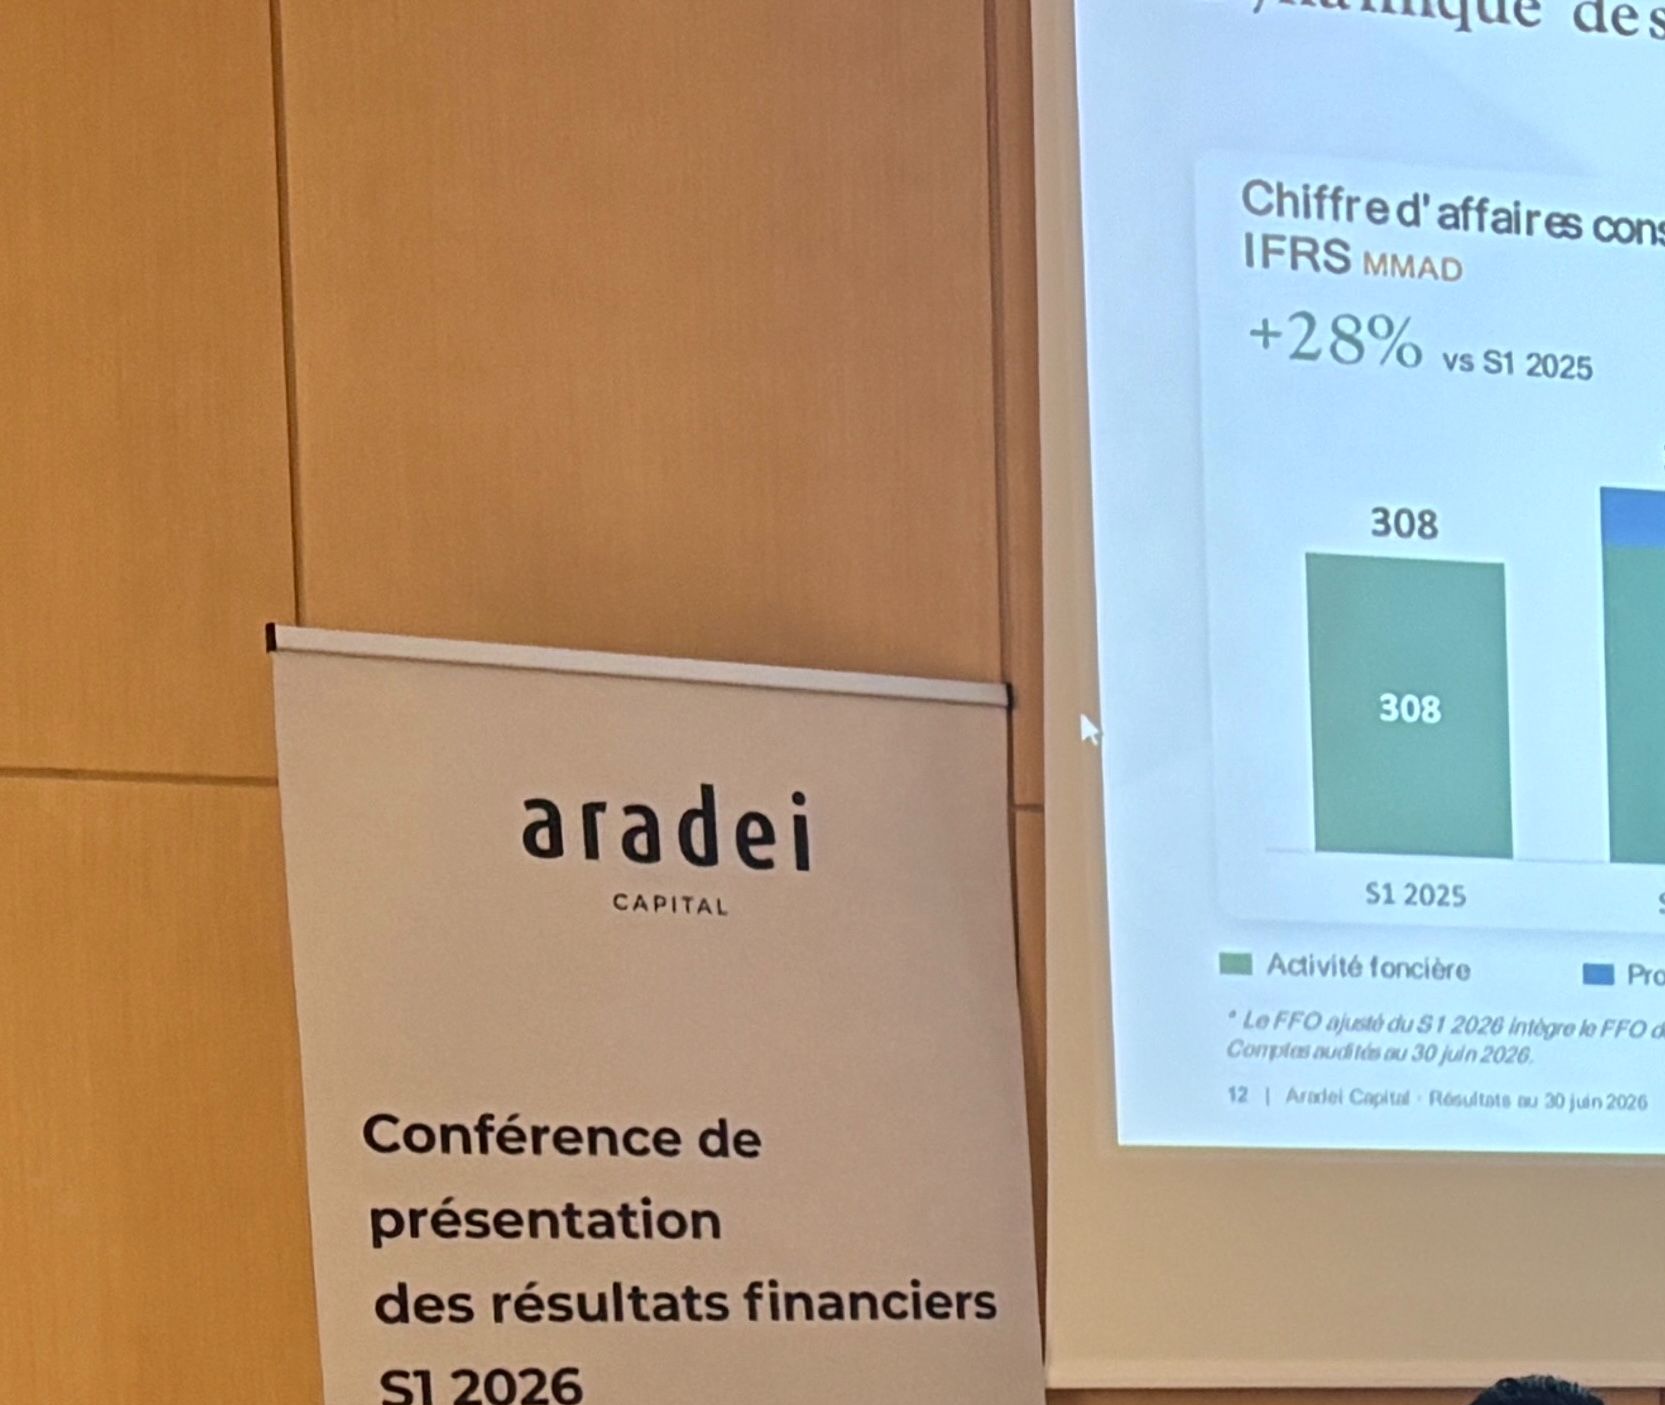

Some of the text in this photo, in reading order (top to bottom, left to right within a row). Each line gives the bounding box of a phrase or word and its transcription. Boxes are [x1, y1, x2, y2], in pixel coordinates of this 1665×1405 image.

[1242, 179, 1389, 225] Chiffre
[1397, 193, 1583, 240] d'affaires
[1245, 232, 1462, 282] IFRS MMAD
[1250, 311, 1593, 381] +28% vs S1 2025
[1372, 507, 1438, 539] 308
[1380, 693, 1441, 723] 308
[523, 783, 809, 871] aradei
[613, 893, 727, 916] CAPITAL
[1366, 882, 1466, 907] S1 2025
[1267, 952, 1471, 981] Activité foncière
[1243, 1010, 1270, 1030] Le
[1273, 1011, 1322, 1030] FFO
[1326, 1012, 1384, 1036] ajusté
[1387, 1015, 1413, 1033] du
[1417, 1015, 1446, 1034] S1
[1451, 1016, 1504, 1035] 2026
[363, 1113, 761, 1158] Conférence de
[371, 1196, 720, 1249] présentation
[375, 1279, 997, 1324] des résultats financiers
